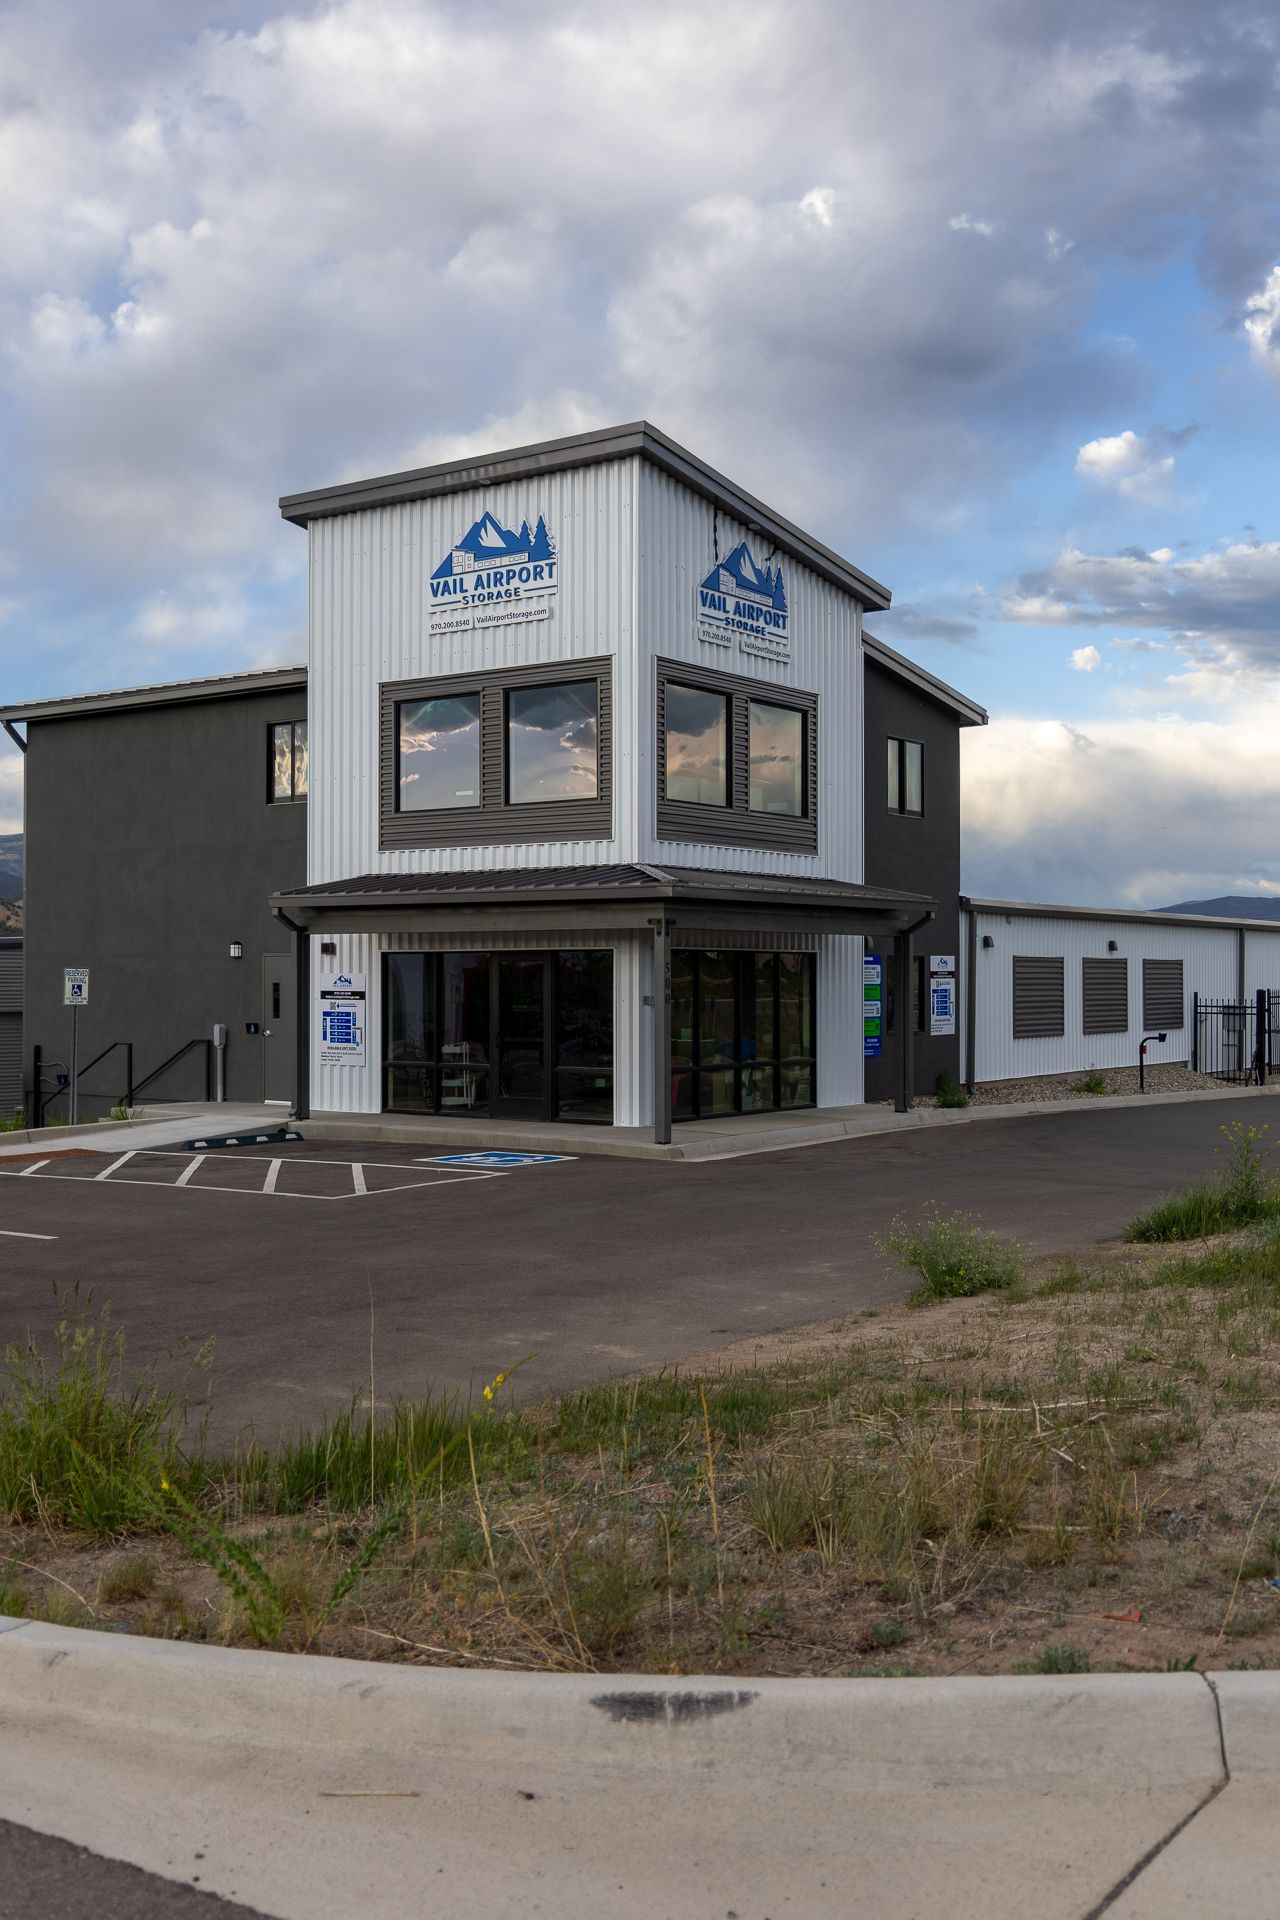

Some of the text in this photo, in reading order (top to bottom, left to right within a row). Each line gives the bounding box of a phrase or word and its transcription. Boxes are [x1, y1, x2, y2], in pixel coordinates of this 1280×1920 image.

[430, 562, 557, 598] VAIL AIRPORT
[462, 587, 521, 605] STORAGE
[430, 608, 547, 631] 970.200.8540 VailAirportStorage.com
[700, 590, 788, 630] VAIL AIRPORT
[724, 617, 767, 636] STORAGE
